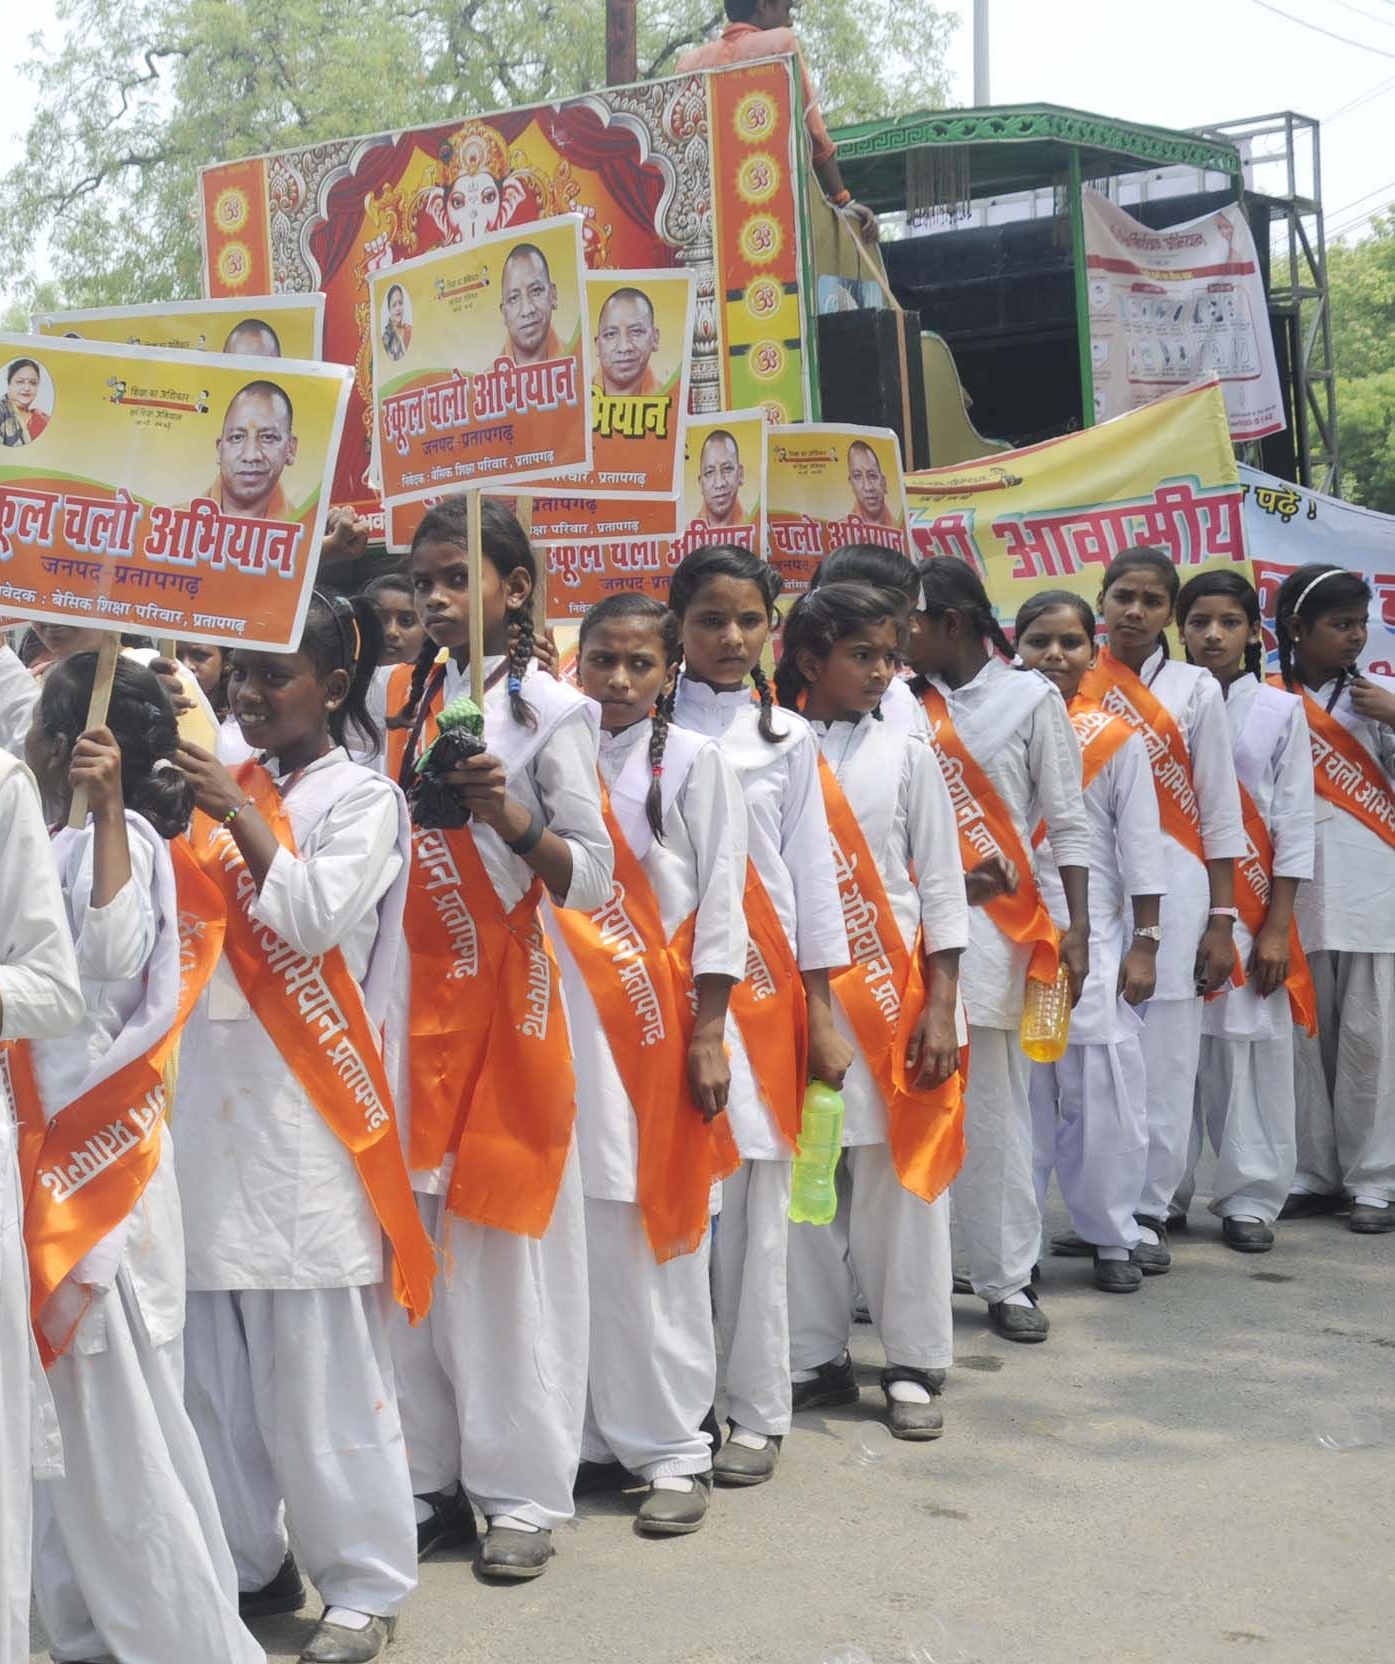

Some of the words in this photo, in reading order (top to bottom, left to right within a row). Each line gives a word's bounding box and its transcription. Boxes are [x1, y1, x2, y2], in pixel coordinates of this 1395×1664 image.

[382, 387, 425, 457] स्कूल
[427, 368, 469, 431] चलो
[474, 355, 578, 423] अभियान
[591, 383, 672, 440] भियान
[597, 471, 647, 488] प्रतापगढ़
[63, 486, 144, 557] चलो
[144, 496, 305, 580] अभियान
[770, 512, 823, 556] चलो
[51, 588, 94, 612] बेसिक
[96, 594, 132, 616] शिक्षा
[192, 612, 247, 636] प्रतापगढ़
[1325, 751, 1364, 796] चलो
[436, 889, 478, 981] प्रतापगढ़
[592, 878, 646, 963] भियान
[260, 930, 349, 1046] अभियान
[326, 1035, 389, 1135] प्रतापगढ़
[515, 943, 551, 1041] प्रतापगढ़
[618, 958, 666, 1048] प्रतापगढ़
[37, 1118, 140, 1204] प्रतापगढ़
